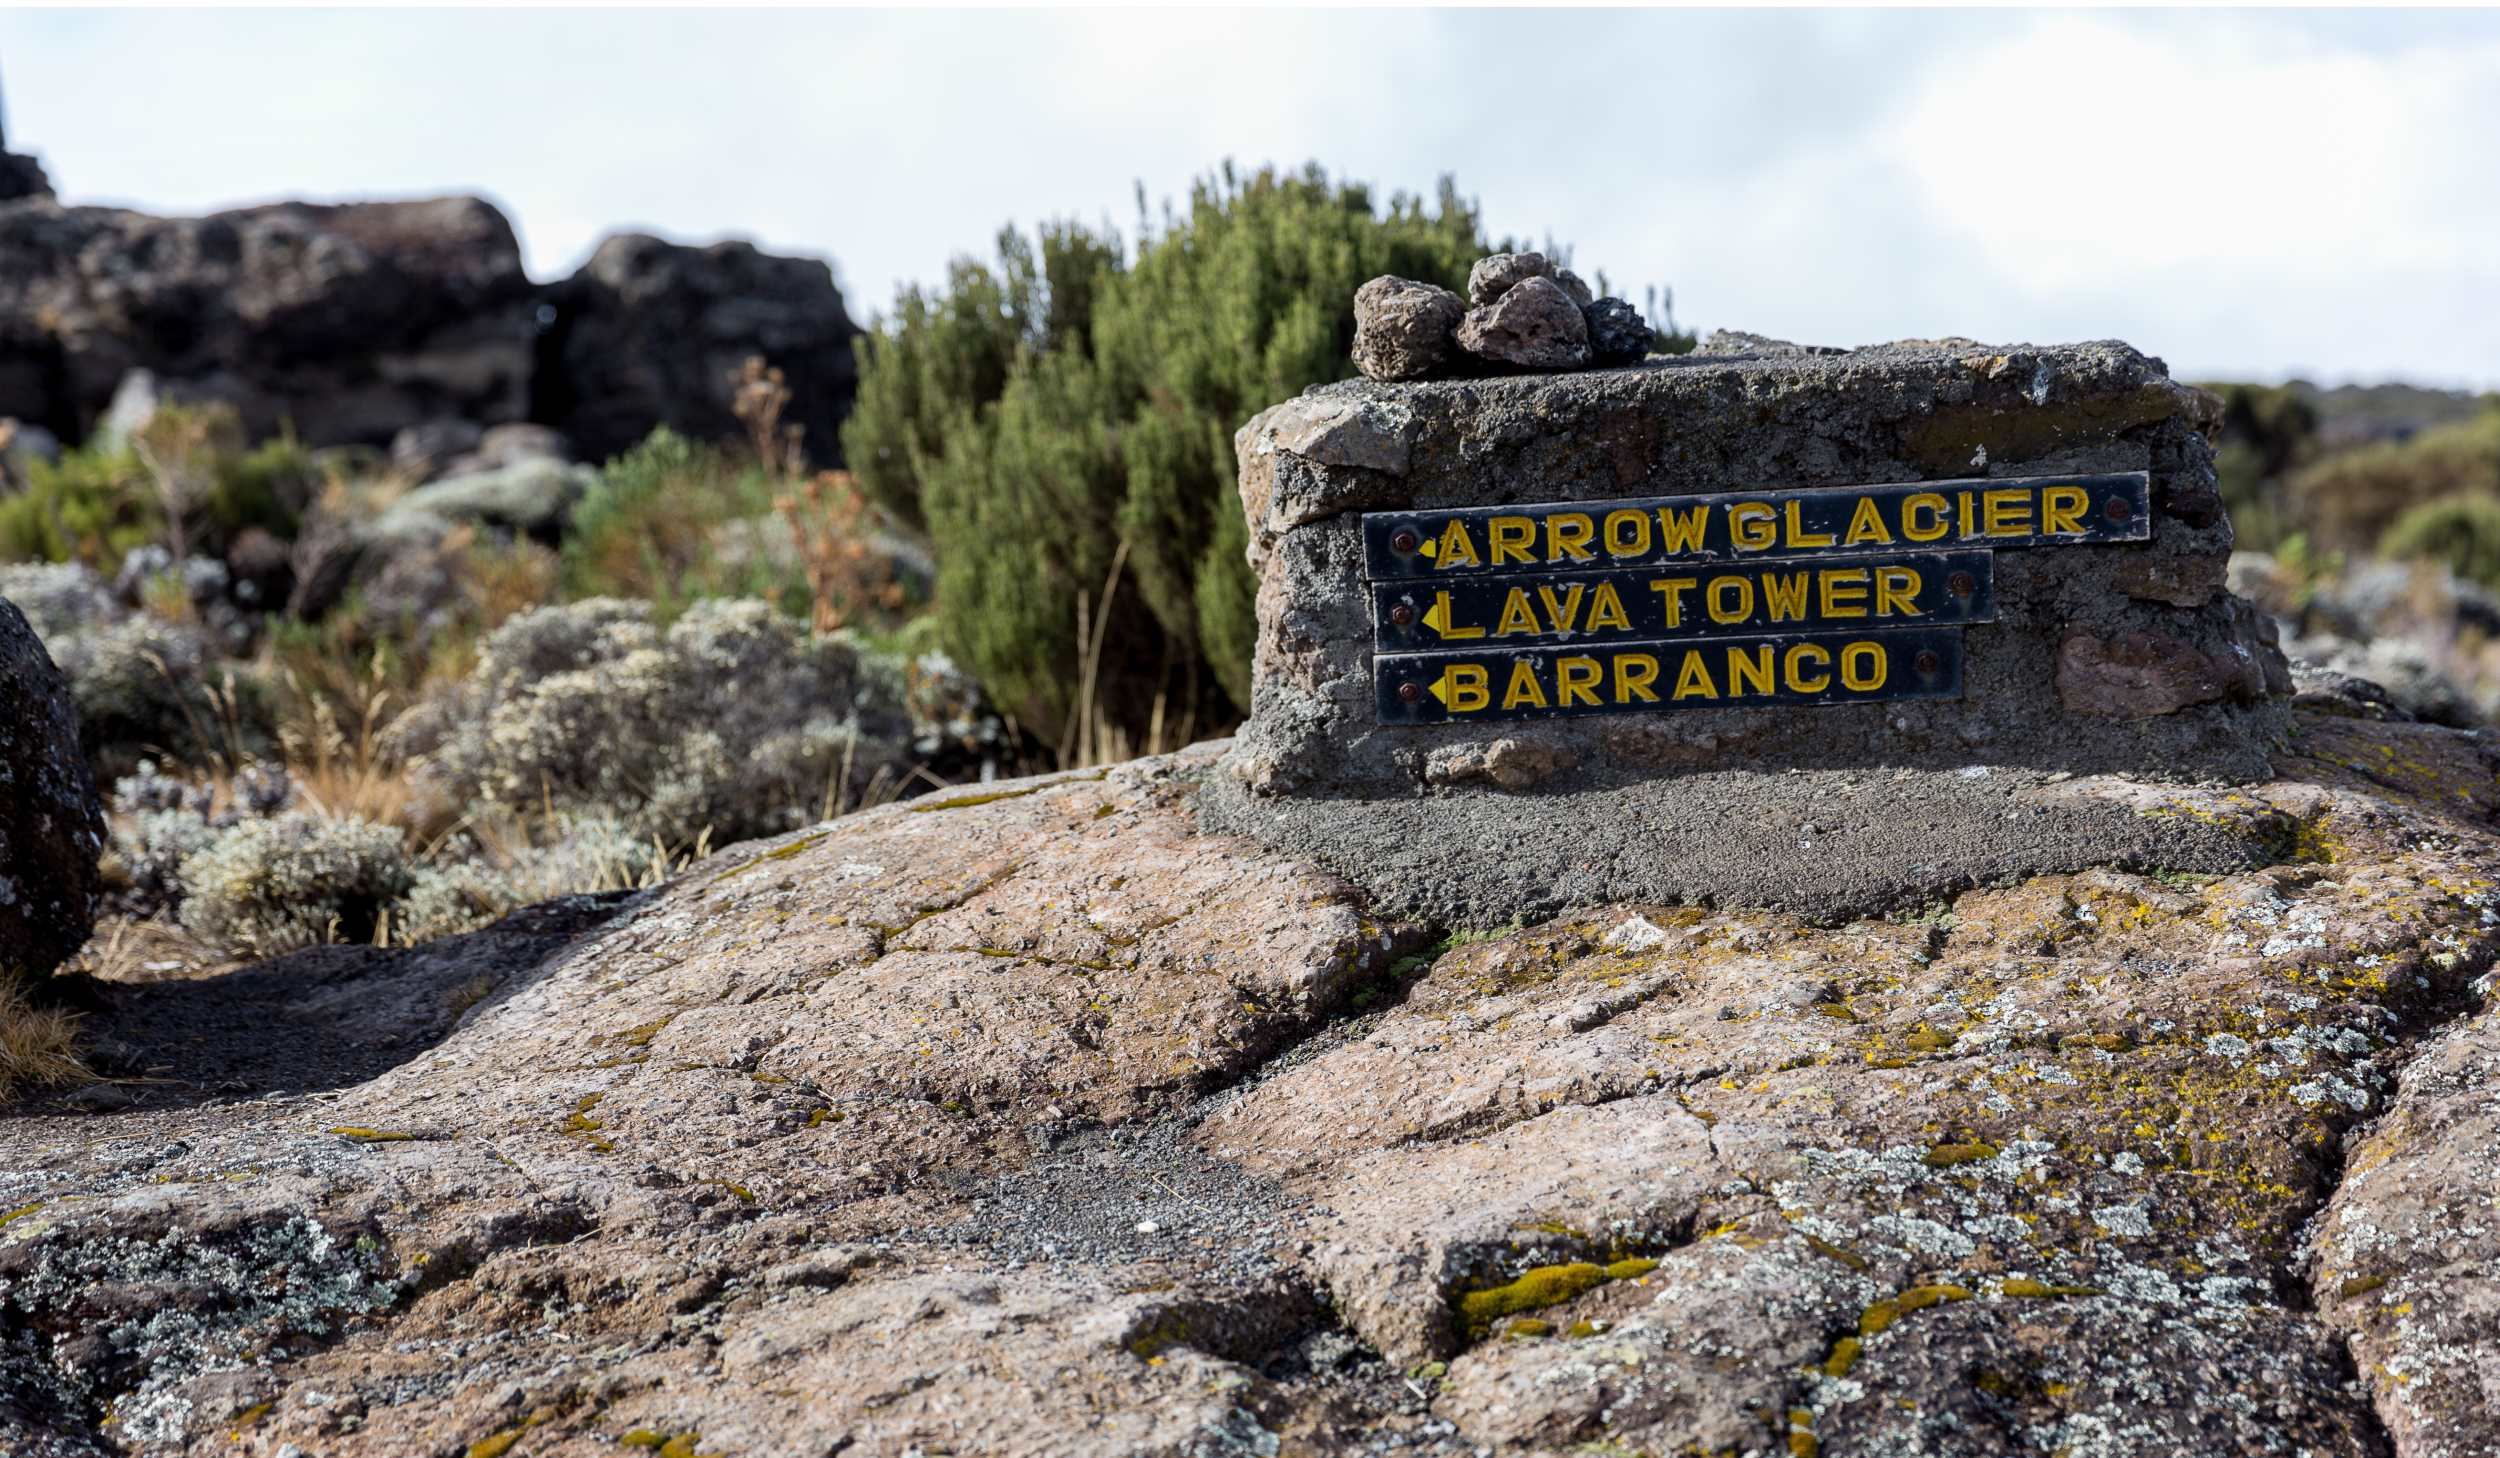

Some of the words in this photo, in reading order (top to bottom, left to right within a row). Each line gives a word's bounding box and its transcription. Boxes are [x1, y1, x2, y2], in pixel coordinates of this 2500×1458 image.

[1434, 505, 1710, 570] ARROW
[1729, 486, 2091, 551] GLACIER
[1437, 583, 1634, 640] LAVA
[1651, 566, 1922, 630] TOWER
[1445, 641, 1888, 712] BARRANCO
